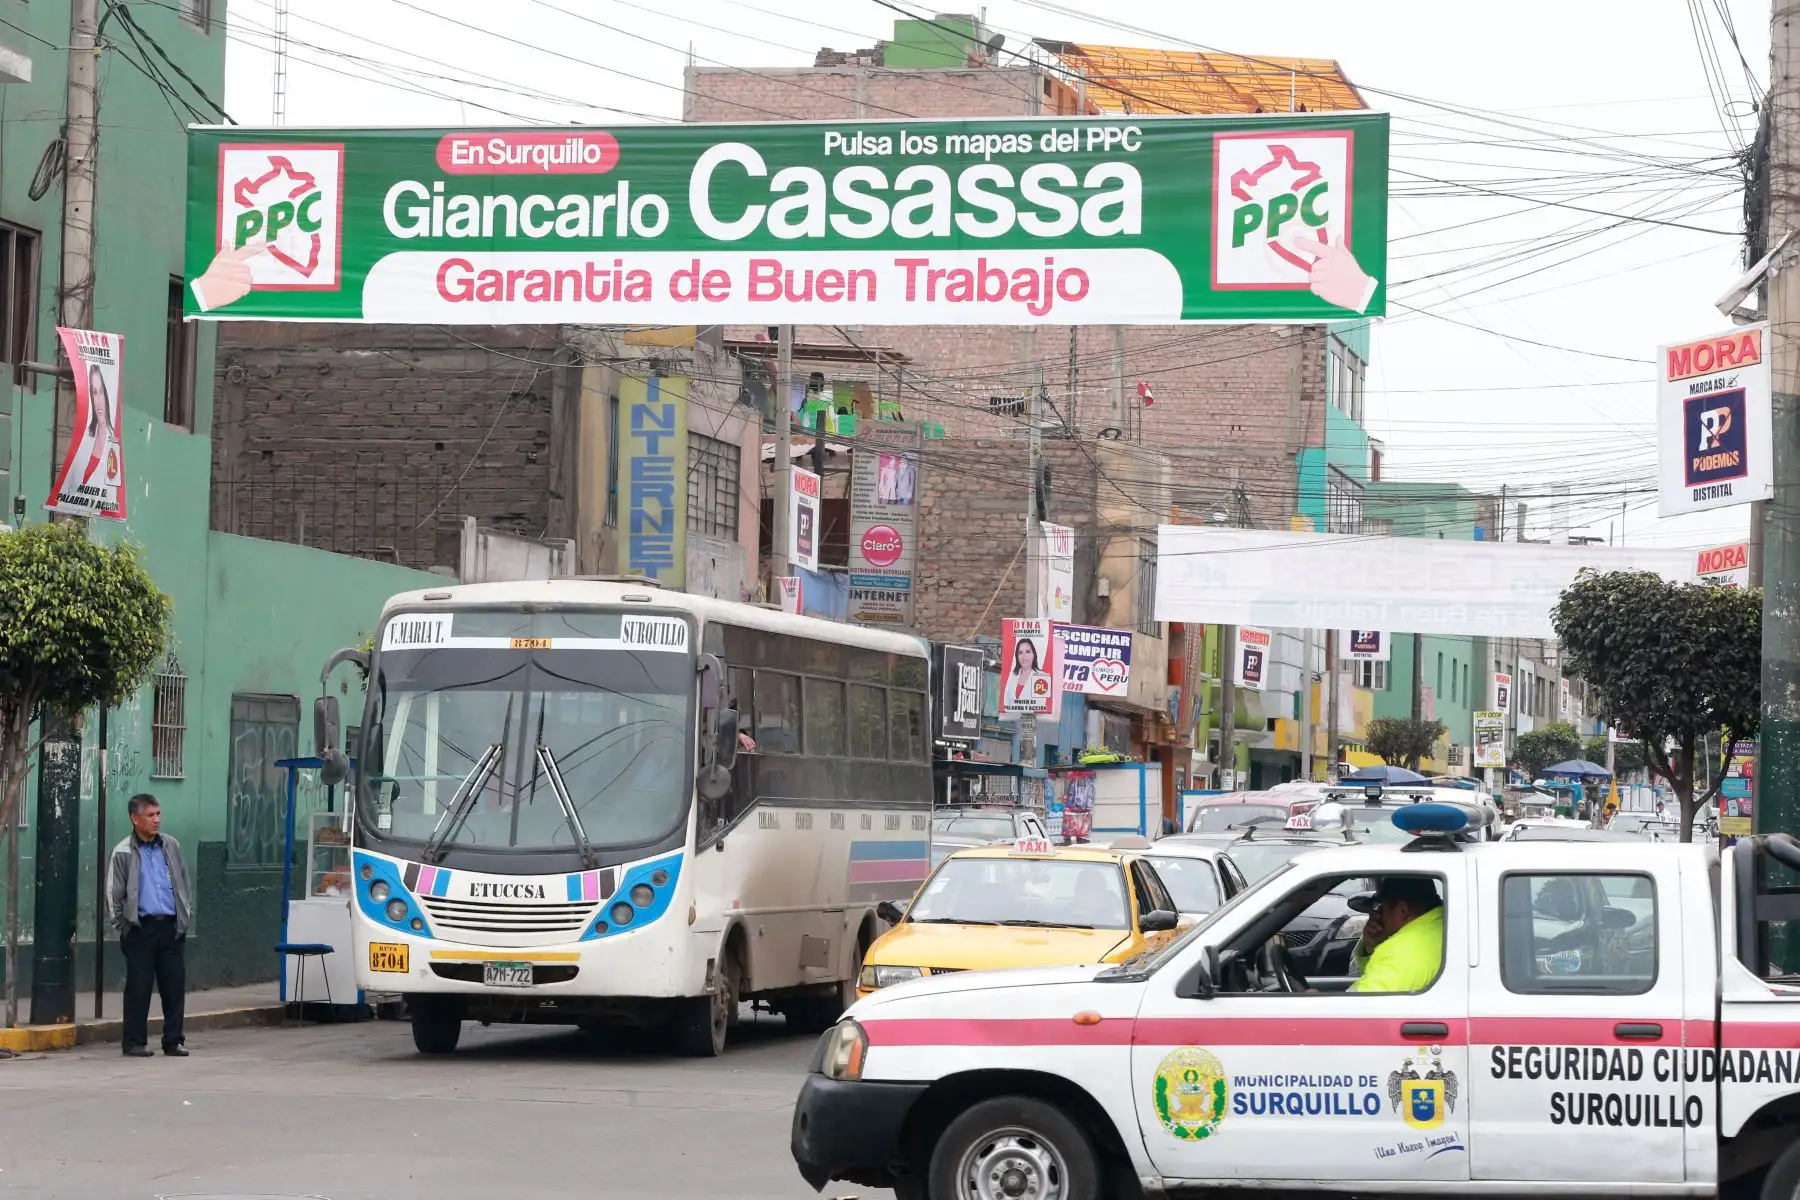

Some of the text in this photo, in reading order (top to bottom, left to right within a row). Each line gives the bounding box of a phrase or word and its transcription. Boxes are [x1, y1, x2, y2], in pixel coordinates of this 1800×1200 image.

[451, 137, 602, 172] En Surquillo
[824, 126, 1143, 161] Pulsa los mapas del PPC
[382, 142, 1143, 241] Giancarlo Casassa
[235, 191, 322, 248] PPC
[1231, 181, 1329, 249] PPC
[436, 257, 1089, 317] Garantia de Buen Trabajo
[1668, 335, 1758, 378] MORA
[1693, 450, 1740, 472] PODEMOS
[77, 484, 101, 496] MUJER
[629, 377, 675, 581] INTERNET
[795, 472, 818, 497] MORA
[57, 493, 89, 508] PALABRA
[89, 500, 96, 508] Y
[1693, 482, 1733, 502] DISTRITAL
[863, 537, 901, 552] Claro
[1697, 546, 1746, 573] MORA
[848, 590, 910, 602] INTERNET
[623, 621, 686, 646] SURQUILLO
[1091, 666, 1114, 674] SOMOS
[1035, 683, 1047, 691] PL
[1291, 819, 1310, 827] TAX
[1018, 840, 1048, 853] TAXI
[470, 882, 546, 900] ETUCCSA
[372, 953, 404, 969] 8704
[1491, 1046, 1644, 1082] SEGURIDAD
[1234, 1075, 1378, 1088] MUNICIPALIDAD DE
[1232, 1092, 1381, 1116] SURQUILLO
[1549, 1093, 1704, 1128] SURQUILLO
